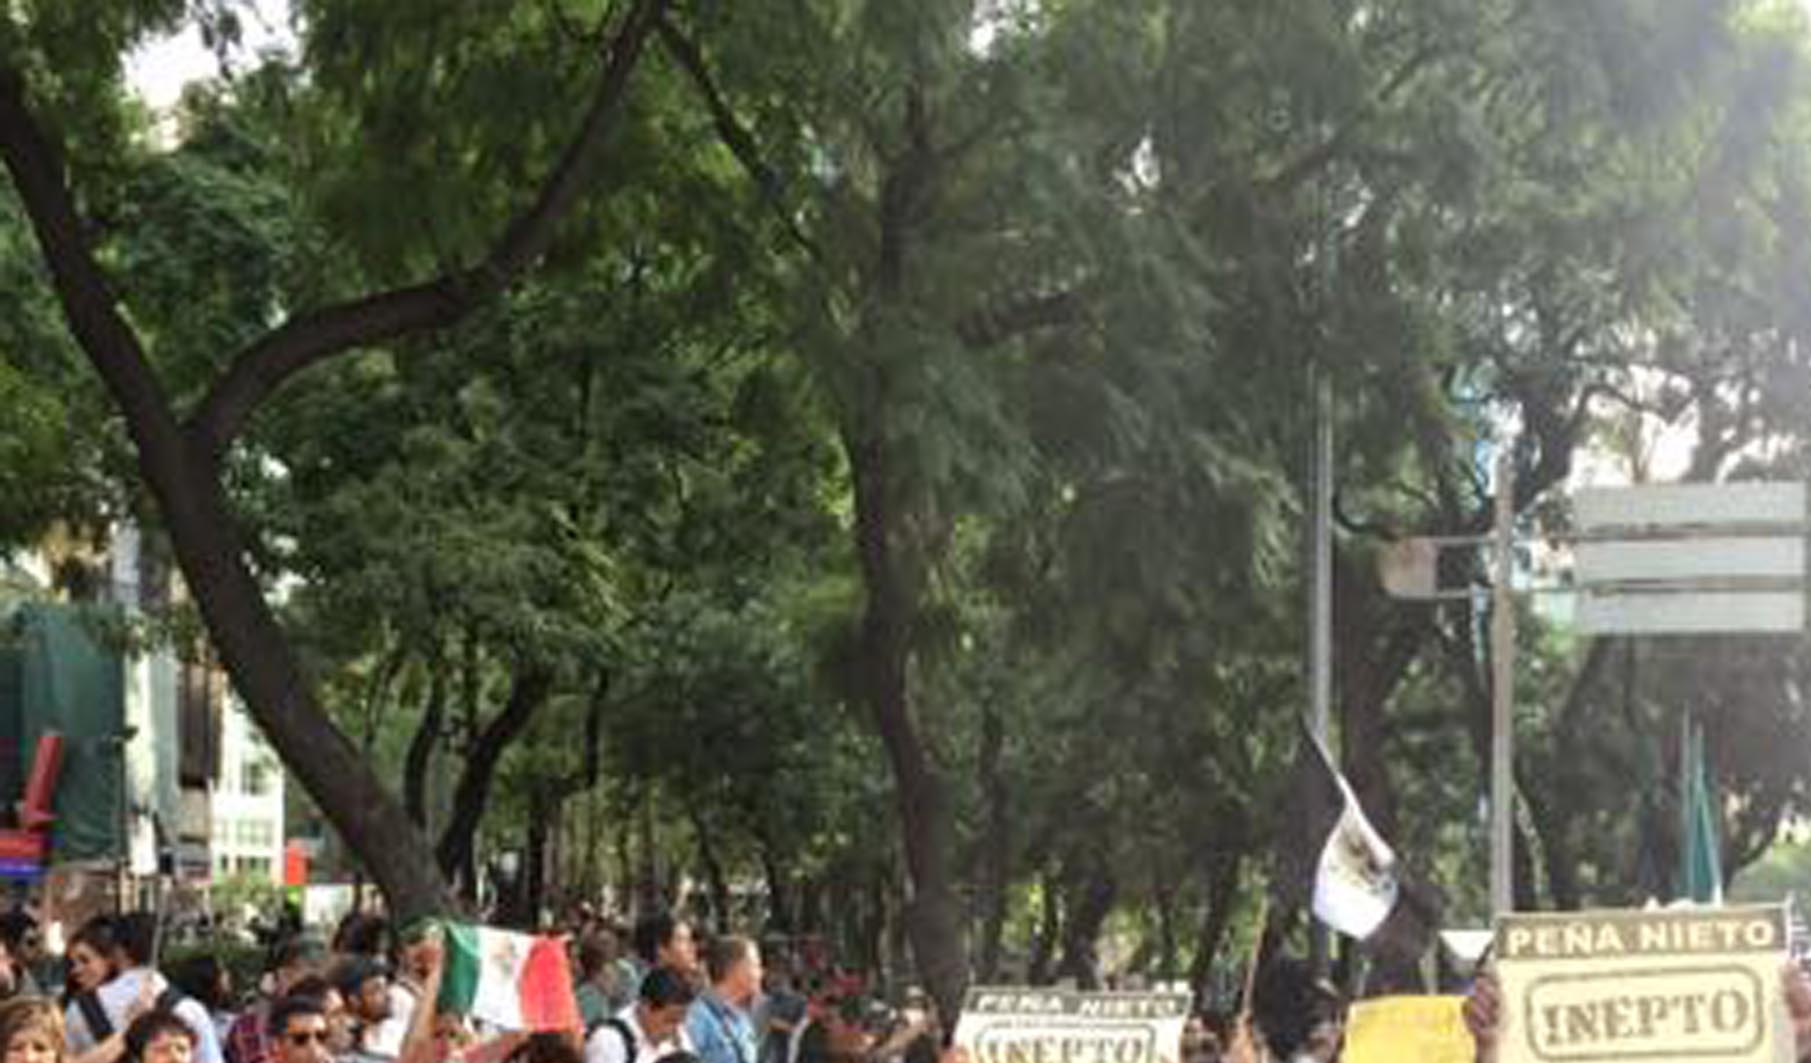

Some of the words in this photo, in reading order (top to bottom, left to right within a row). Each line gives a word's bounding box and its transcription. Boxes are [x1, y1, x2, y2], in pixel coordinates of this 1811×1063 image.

[1507, 919, 1623, 956] PEÑA
[1640, 917, 1775, 951] NIETO
[1542, 986, 1750, 1047] INEPTO
